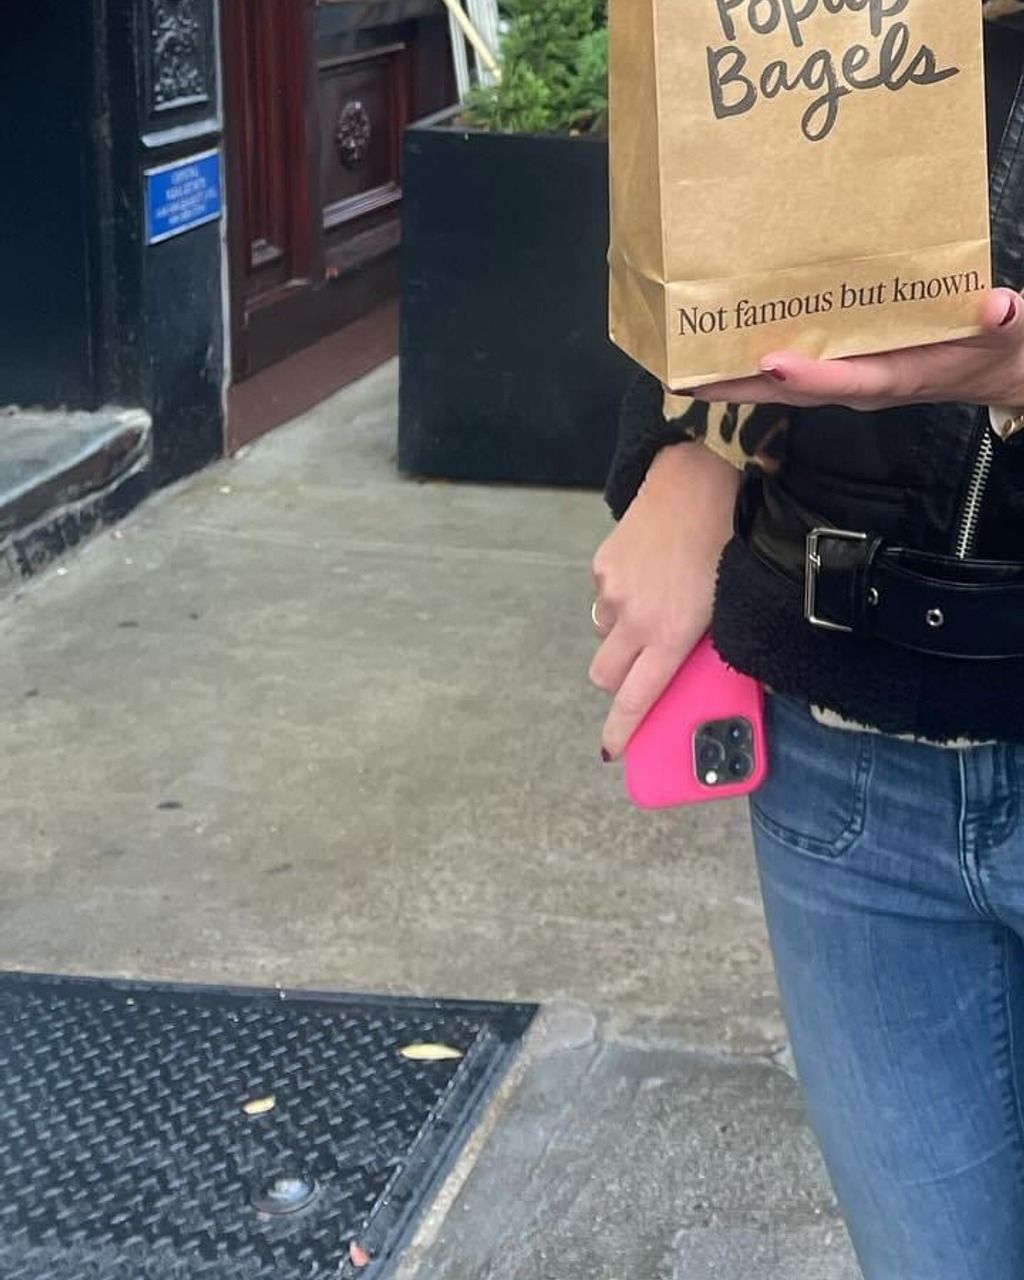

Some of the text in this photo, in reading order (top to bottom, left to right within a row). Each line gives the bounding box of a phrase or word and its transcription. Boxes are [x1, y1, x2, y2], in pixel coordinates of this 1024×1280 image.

[707, 22, 960, 141] Bagels
[679, 270, 986, 336] Not famous but known.
